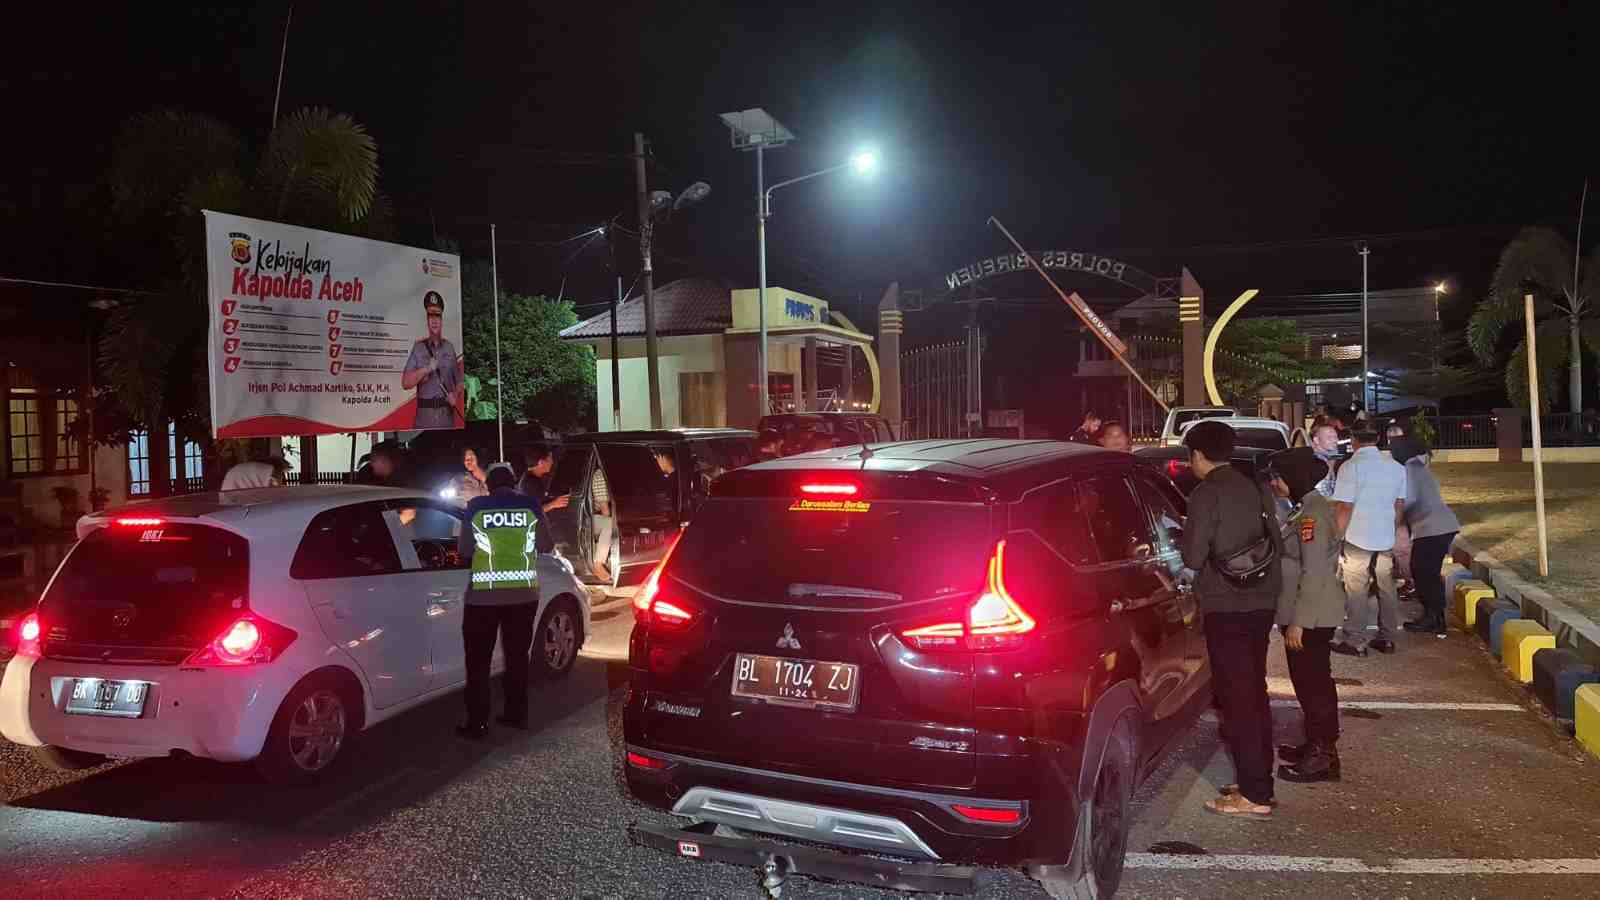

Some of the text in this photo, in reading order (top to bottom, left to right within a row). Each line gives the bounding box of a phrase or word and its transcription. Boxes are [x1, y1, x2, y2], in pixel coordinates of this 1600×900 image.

[255, 238, 331, 276] Kebijakan
[232, 267, 364, 303] Kapolda Aceh
[248, 381, 268, 394] Irjen
[271, 383, 286, 393] Pol
[288, 382, 323, 393] Achmad
[342, 395, 391, 405] Kapolda Aceh
[483, 512, 528, 528] POLISI
[738, 658, 852, 691] BL 1704 ZJ
[73, 682, 89, 699] BK
